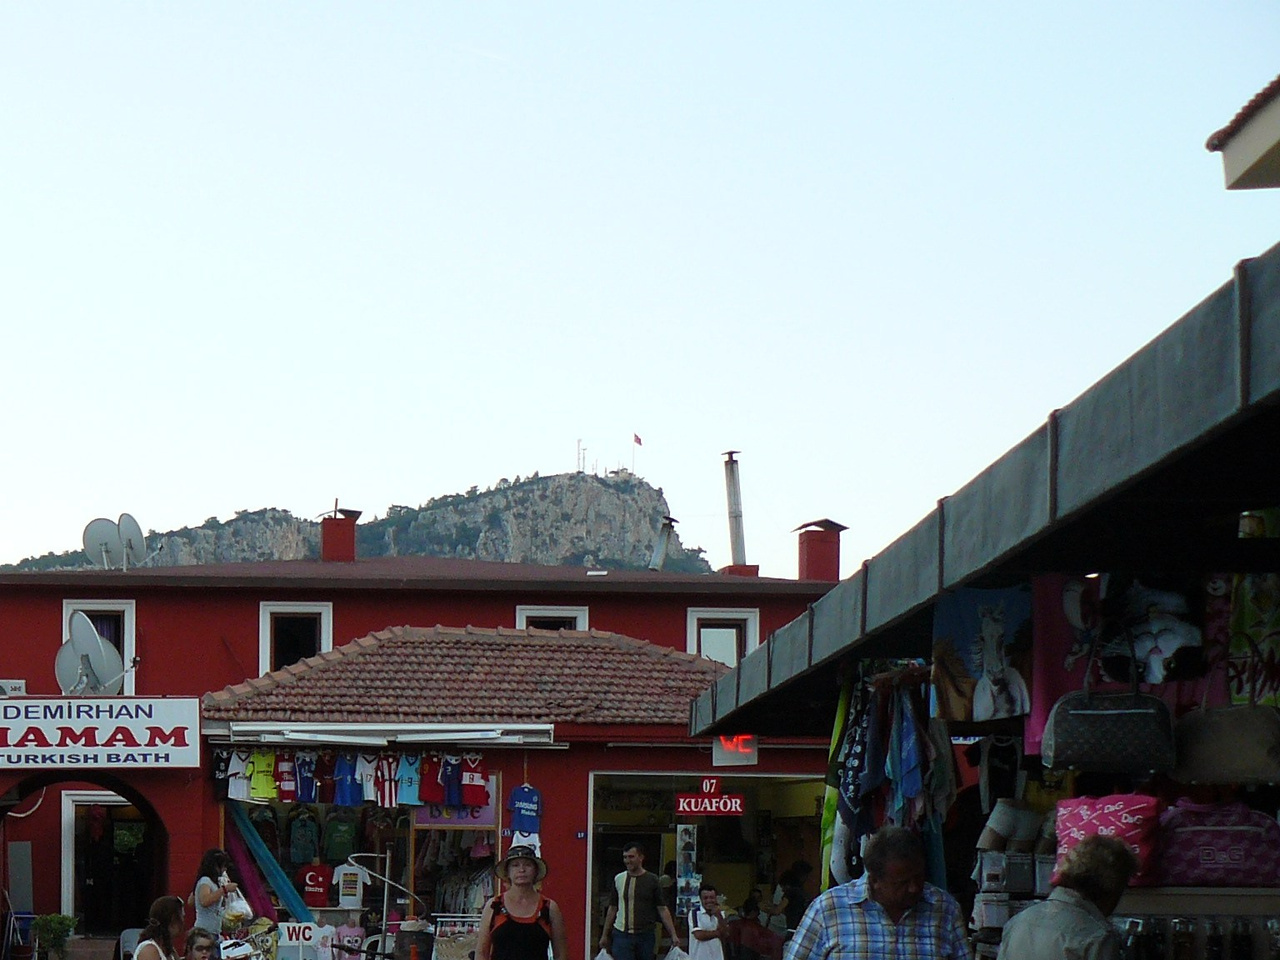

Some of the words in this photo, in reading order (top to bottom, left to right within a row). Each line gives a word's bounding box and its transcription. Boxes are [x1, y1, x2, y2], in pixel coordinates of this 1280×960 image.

[719, 735, 754, 753] WC
[106, 753, 170, 763] BATH
[702, 779, 717, 794] 07
[678, 795, 743, 813] KUAFÖR
[287, 926, 313, 942] WC
